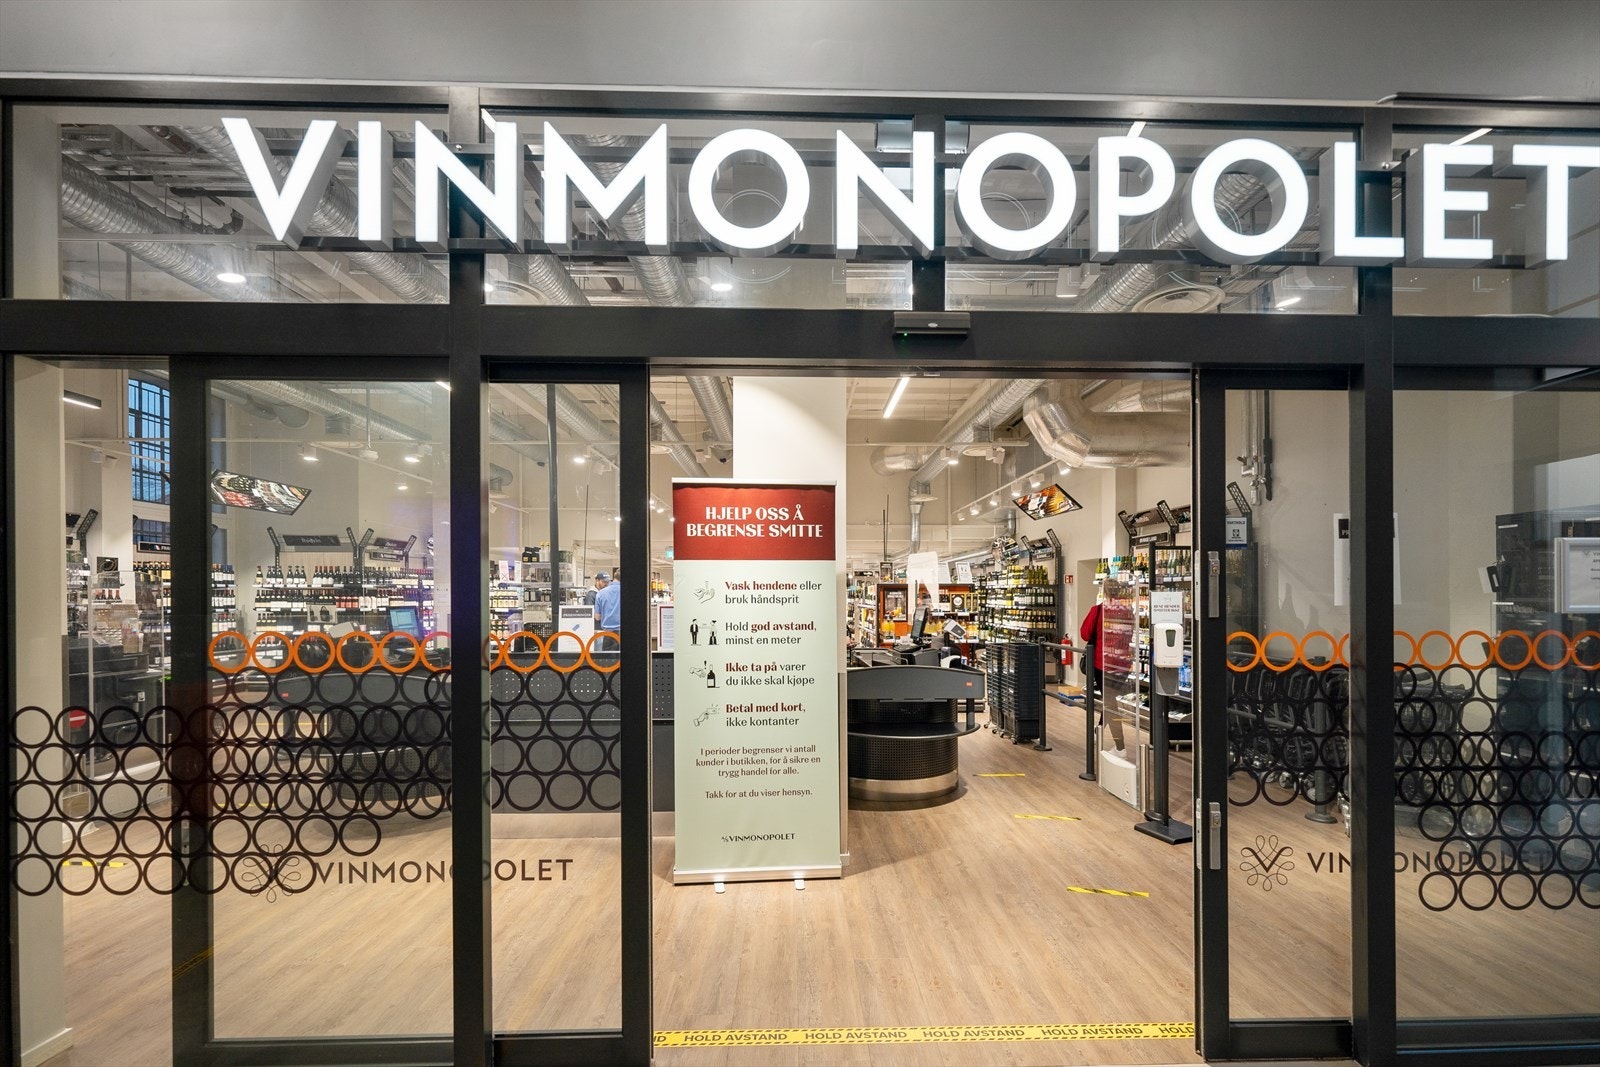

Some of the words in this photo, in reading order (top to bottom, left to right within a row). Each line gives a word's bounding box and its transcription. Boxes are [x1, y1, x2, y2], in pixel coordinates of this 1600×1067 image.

[221, 117, 1600, 261] VINMONOPOLET
[706, 507, 752, 520] HJELP
[756, 507, 789, 520] OSS
[793, 504, 804, 520] Å
[687, 524, 764, 537] BEGRENSE
[769, 524, 822, 537] SMITTE
[725, 581, 750, 590] Vask
[753, 581, 797, 590] hendene
[800, 581, 822, 590] eller
[726, 595, 748, 604] bruk
[751, 595, 799, 605] håndsprit
[726, 622, 748, 631] Hold
[751, 622, 770, 633] god
[773, 621, 817, 632] avstand,
[726, 636, 754, 644] minst
[771, 636, 801, 644] meter
[726, 663, 748, 671] Ikke
[751, 663, 761, 671] ta
[765, 662, 777, 673] på
[726, 676, 738, 686] du
[741, 676, 761, 685] ikke
[765, 676, 784, 685] skal
[788, 675, 814, 686] kjøpe
[726, 703, 753, 713] Betal
[756, 703, 778, 712] med
[781, 703, 806, 713] kort,
[727, 717, 747, 726] ikke
[750, 717, 799, 726] kontanter
[705, 747, 740, 757] perioder
[743, 747, 782, 756] begrenser
[785, 745, 792, 753] vi
[696, 758, 724, 766] kunder
[731, 757, 767, 765] butikken,
[719, 768, 739, 778] trygg
[770, 767, 781, 775] for
[726, 790, 737, 798] for
[782, 788, 813, 797] hensyn.
[729, 833, 796, 842] VINMONOPOLET
[315, 858, 573, 885] VINMONOLET
[844, 1031, 907, 1039] AVSTAND
[922, 1030, 959, 1038] HOLD
[963, 1029, 1025, 1037] AVSTAND
[1041, 1028, 1078, 1036] HOLD
[1082, 1027, 1143, 1035] AVSTAND
[684, 1034, 722, 1042] HOLD
[725, 1033, 788, 1041] AVSTAND
